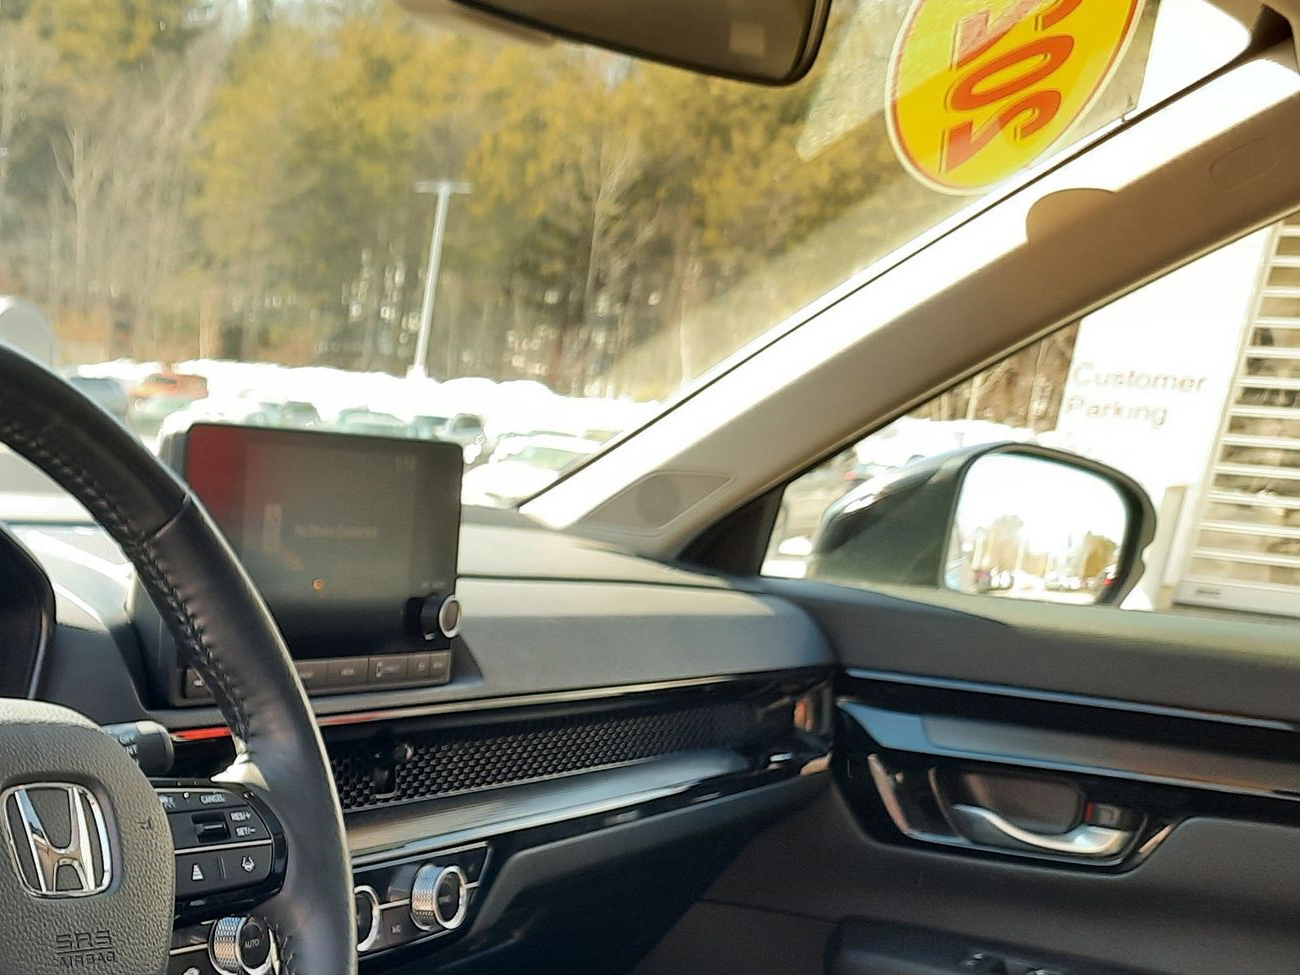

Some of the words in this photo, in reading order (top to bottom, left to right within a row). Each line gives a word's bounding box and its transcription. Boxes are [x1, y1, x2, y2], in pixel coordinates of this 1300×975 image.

[1074, 362, 1208, 392] Customer
[1067, 397, 1167, 426] Parking
[200, 793, 226, 805] CANCEL
[55, 929, 113, 950] SRS
[244, 938, 260, 949] AUTO
[58, 950, 117, 969] AIRBAG
